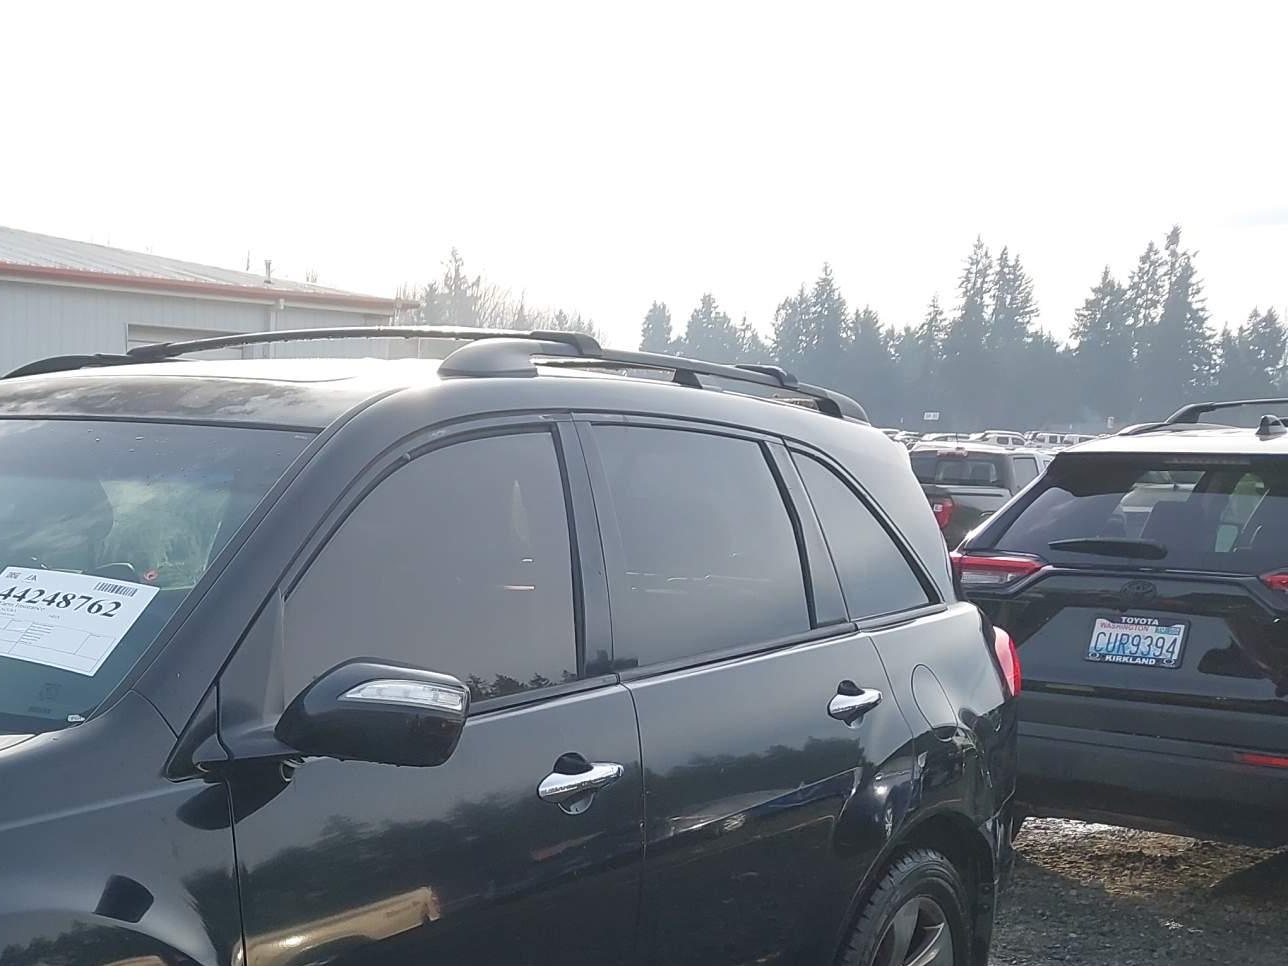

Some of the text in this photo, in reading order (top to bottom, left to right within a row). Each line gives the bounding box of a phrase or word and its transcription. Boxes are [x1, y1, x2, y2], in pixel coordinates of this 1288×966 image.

[1120, 616, 1159, 626] TOYOTA
[1100, 622, 1149, 632] WASHINGTON
[1094, 631, 1178, 659] CUR9394
[1105, 655, 1156, 665] KIRKLAND
